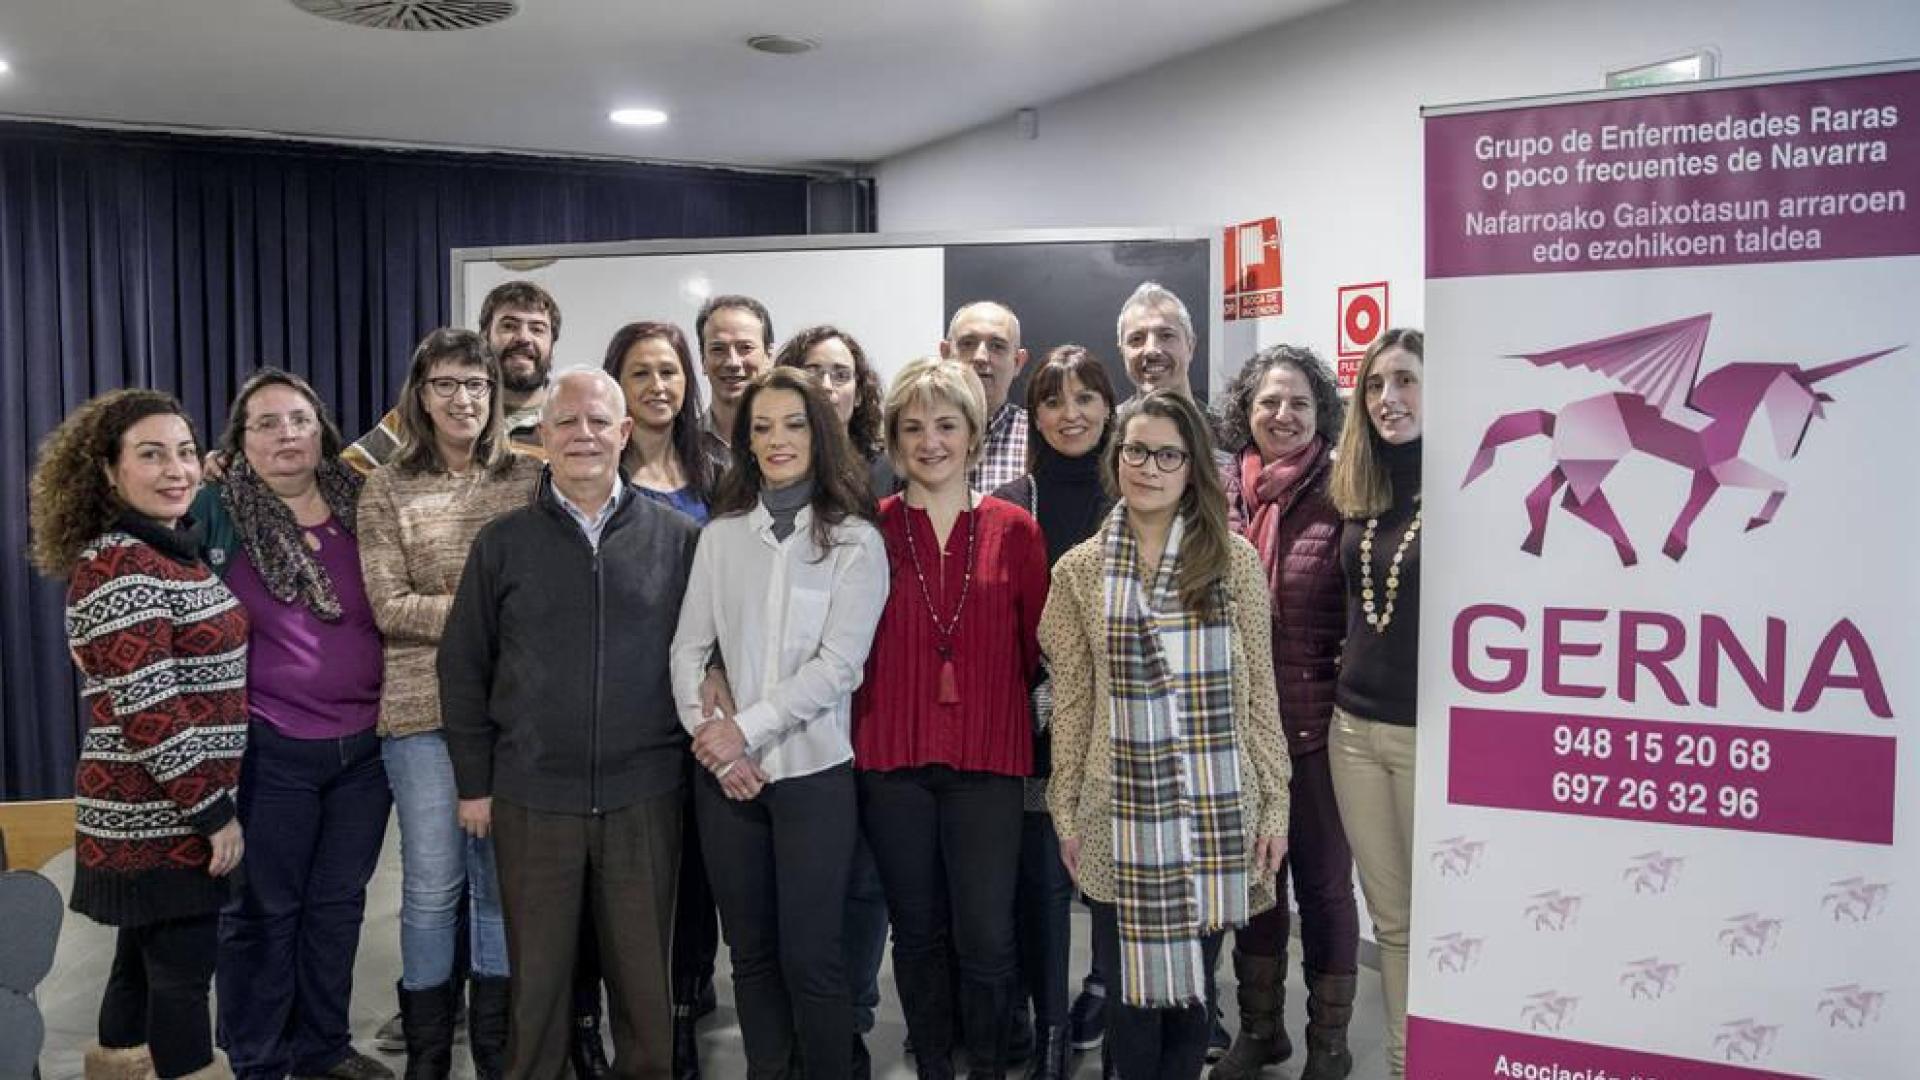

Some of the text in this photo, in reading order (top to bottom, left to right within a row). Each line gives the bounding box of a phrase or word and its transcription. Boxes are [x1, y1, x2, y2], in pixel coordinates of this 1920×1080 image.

[1475, 105, 1898, 164] Grupo de Enfermedades Raras
[1482, 141, 1887, 195] o poco frecuentes de Navarra
[1465, 188, 1906, 236] Nafarroako Gaixotasun arraroen
[1533, 225, 1821, 263] edo ezohikoen taldea
[1451, 603, 1894, 719] GERNA
[1554, 726, 1771, 771] 948 15 20 68
[1552, 772, 1759, 819] 697 26 32 96
[1494, 1054, 1621, 1080] Asociaci
